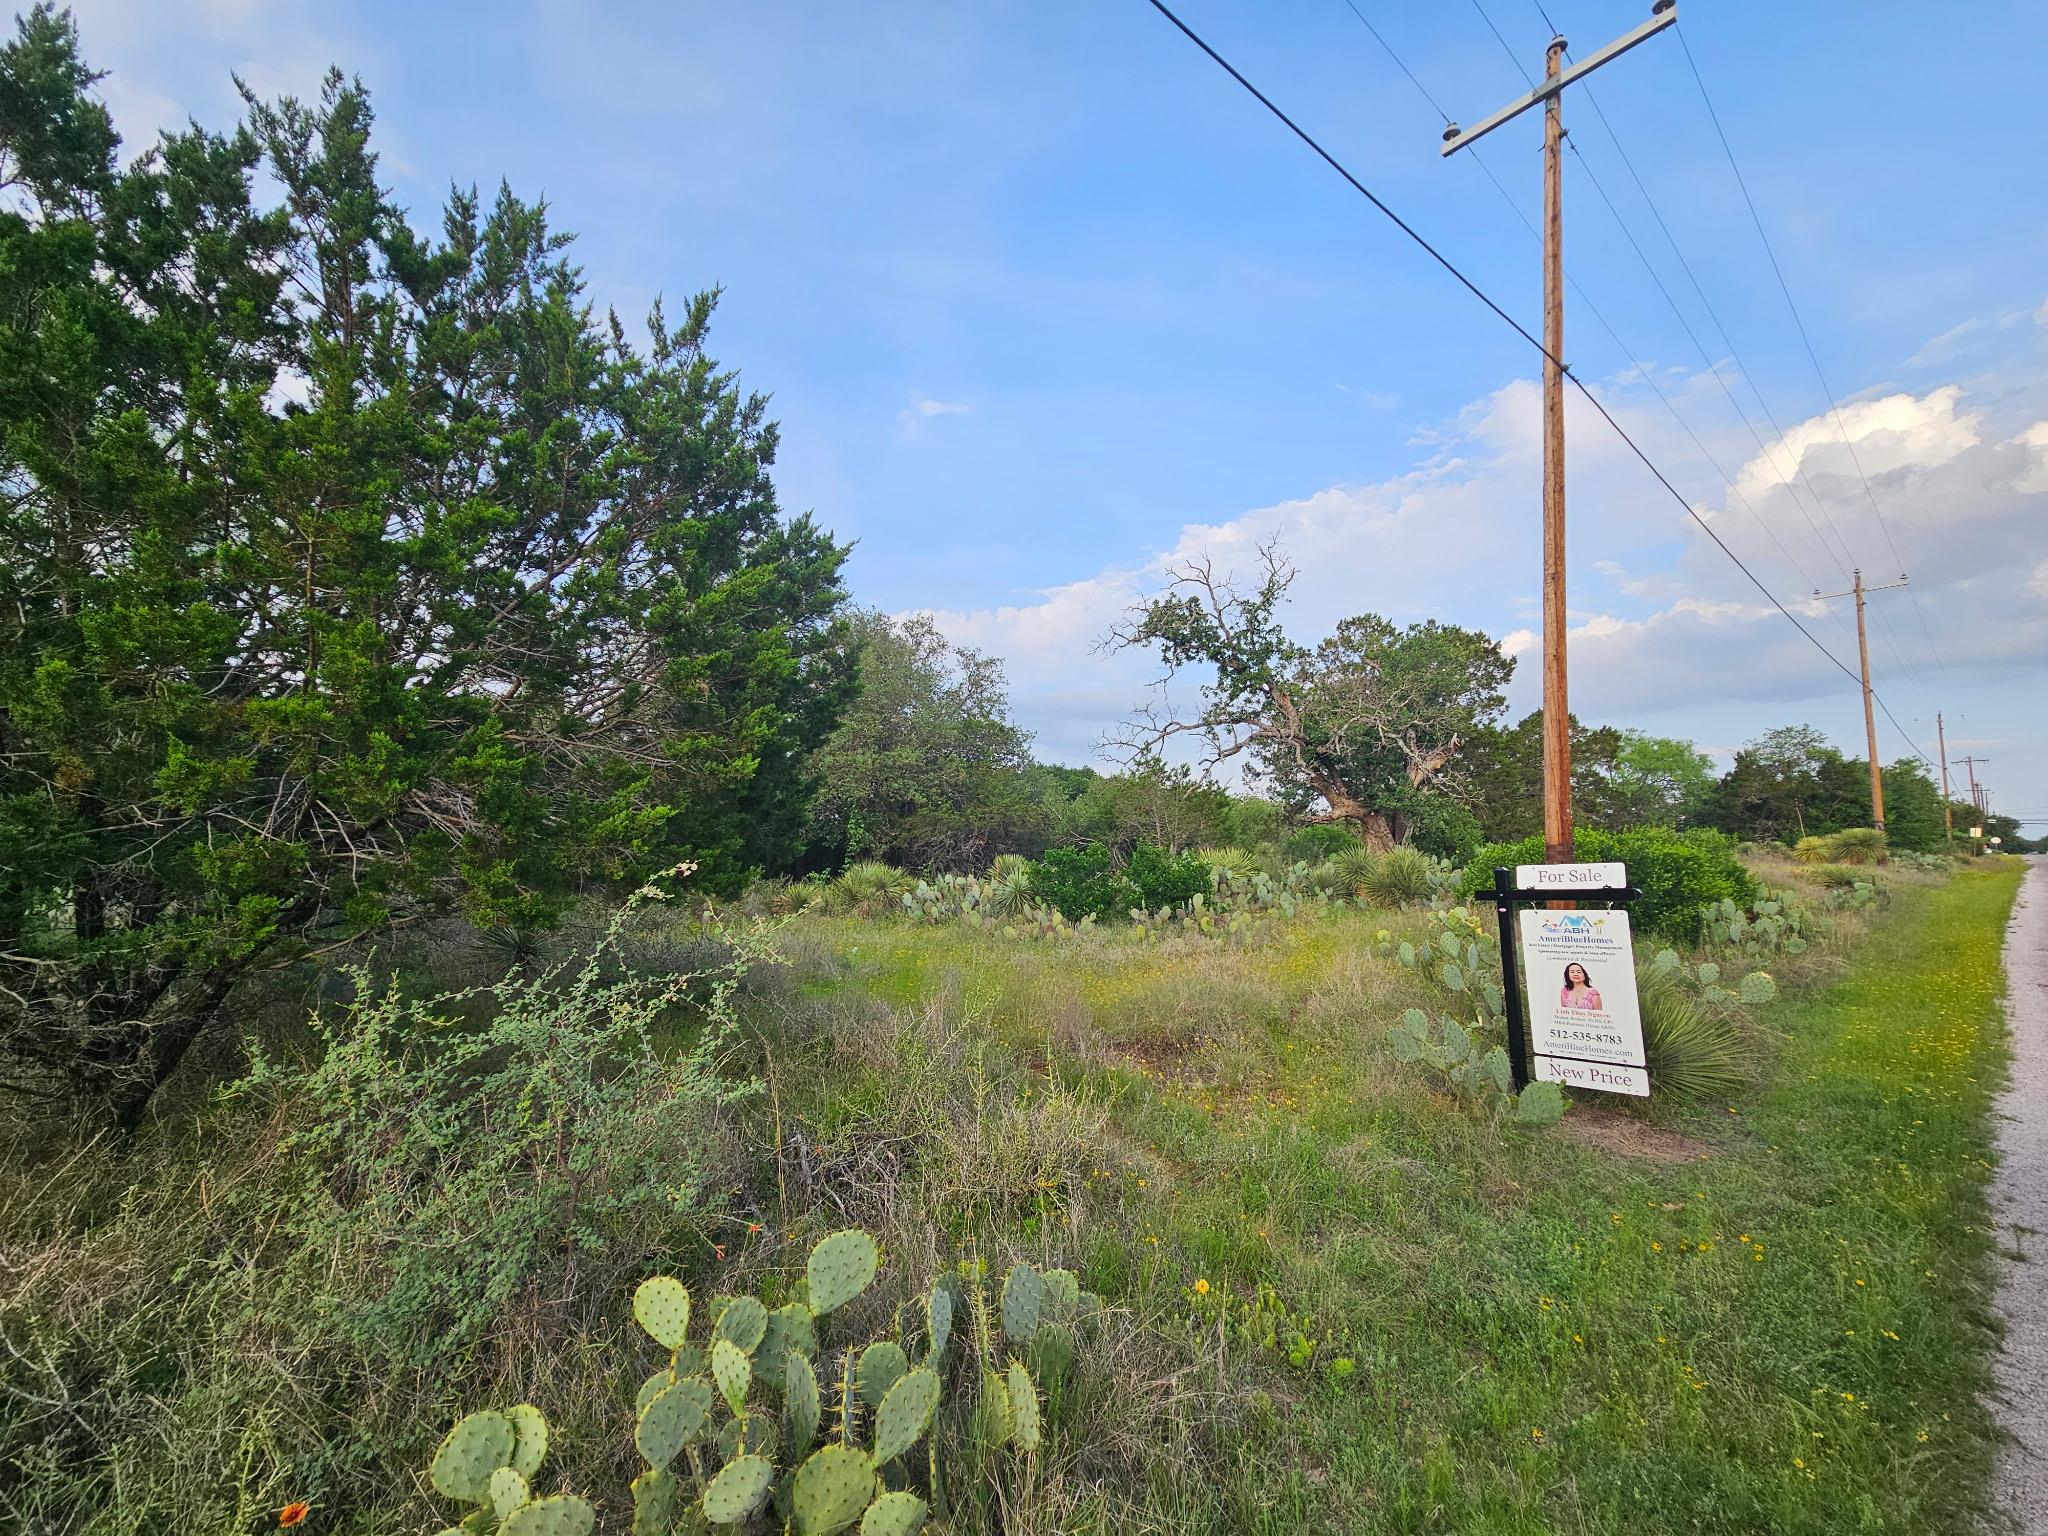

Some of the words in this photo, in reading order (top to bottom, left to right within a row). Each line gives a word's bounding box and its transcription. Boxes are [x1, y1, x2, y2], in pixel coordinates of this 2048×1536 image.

[1538, 870, 1565, 882] For
[1569, 868, 1602, 882] Sale
[1538, 935, 1614, 944] AmeriBlueHomes
[1550, 1029, 1623, 1045] 512-535-8783
[1543, 1040, 1633, 1057] AmeriBlueHomes.com
[1548, 1063, 1585, 1080] New
[1589, 1068, 1633, 1087] Price
